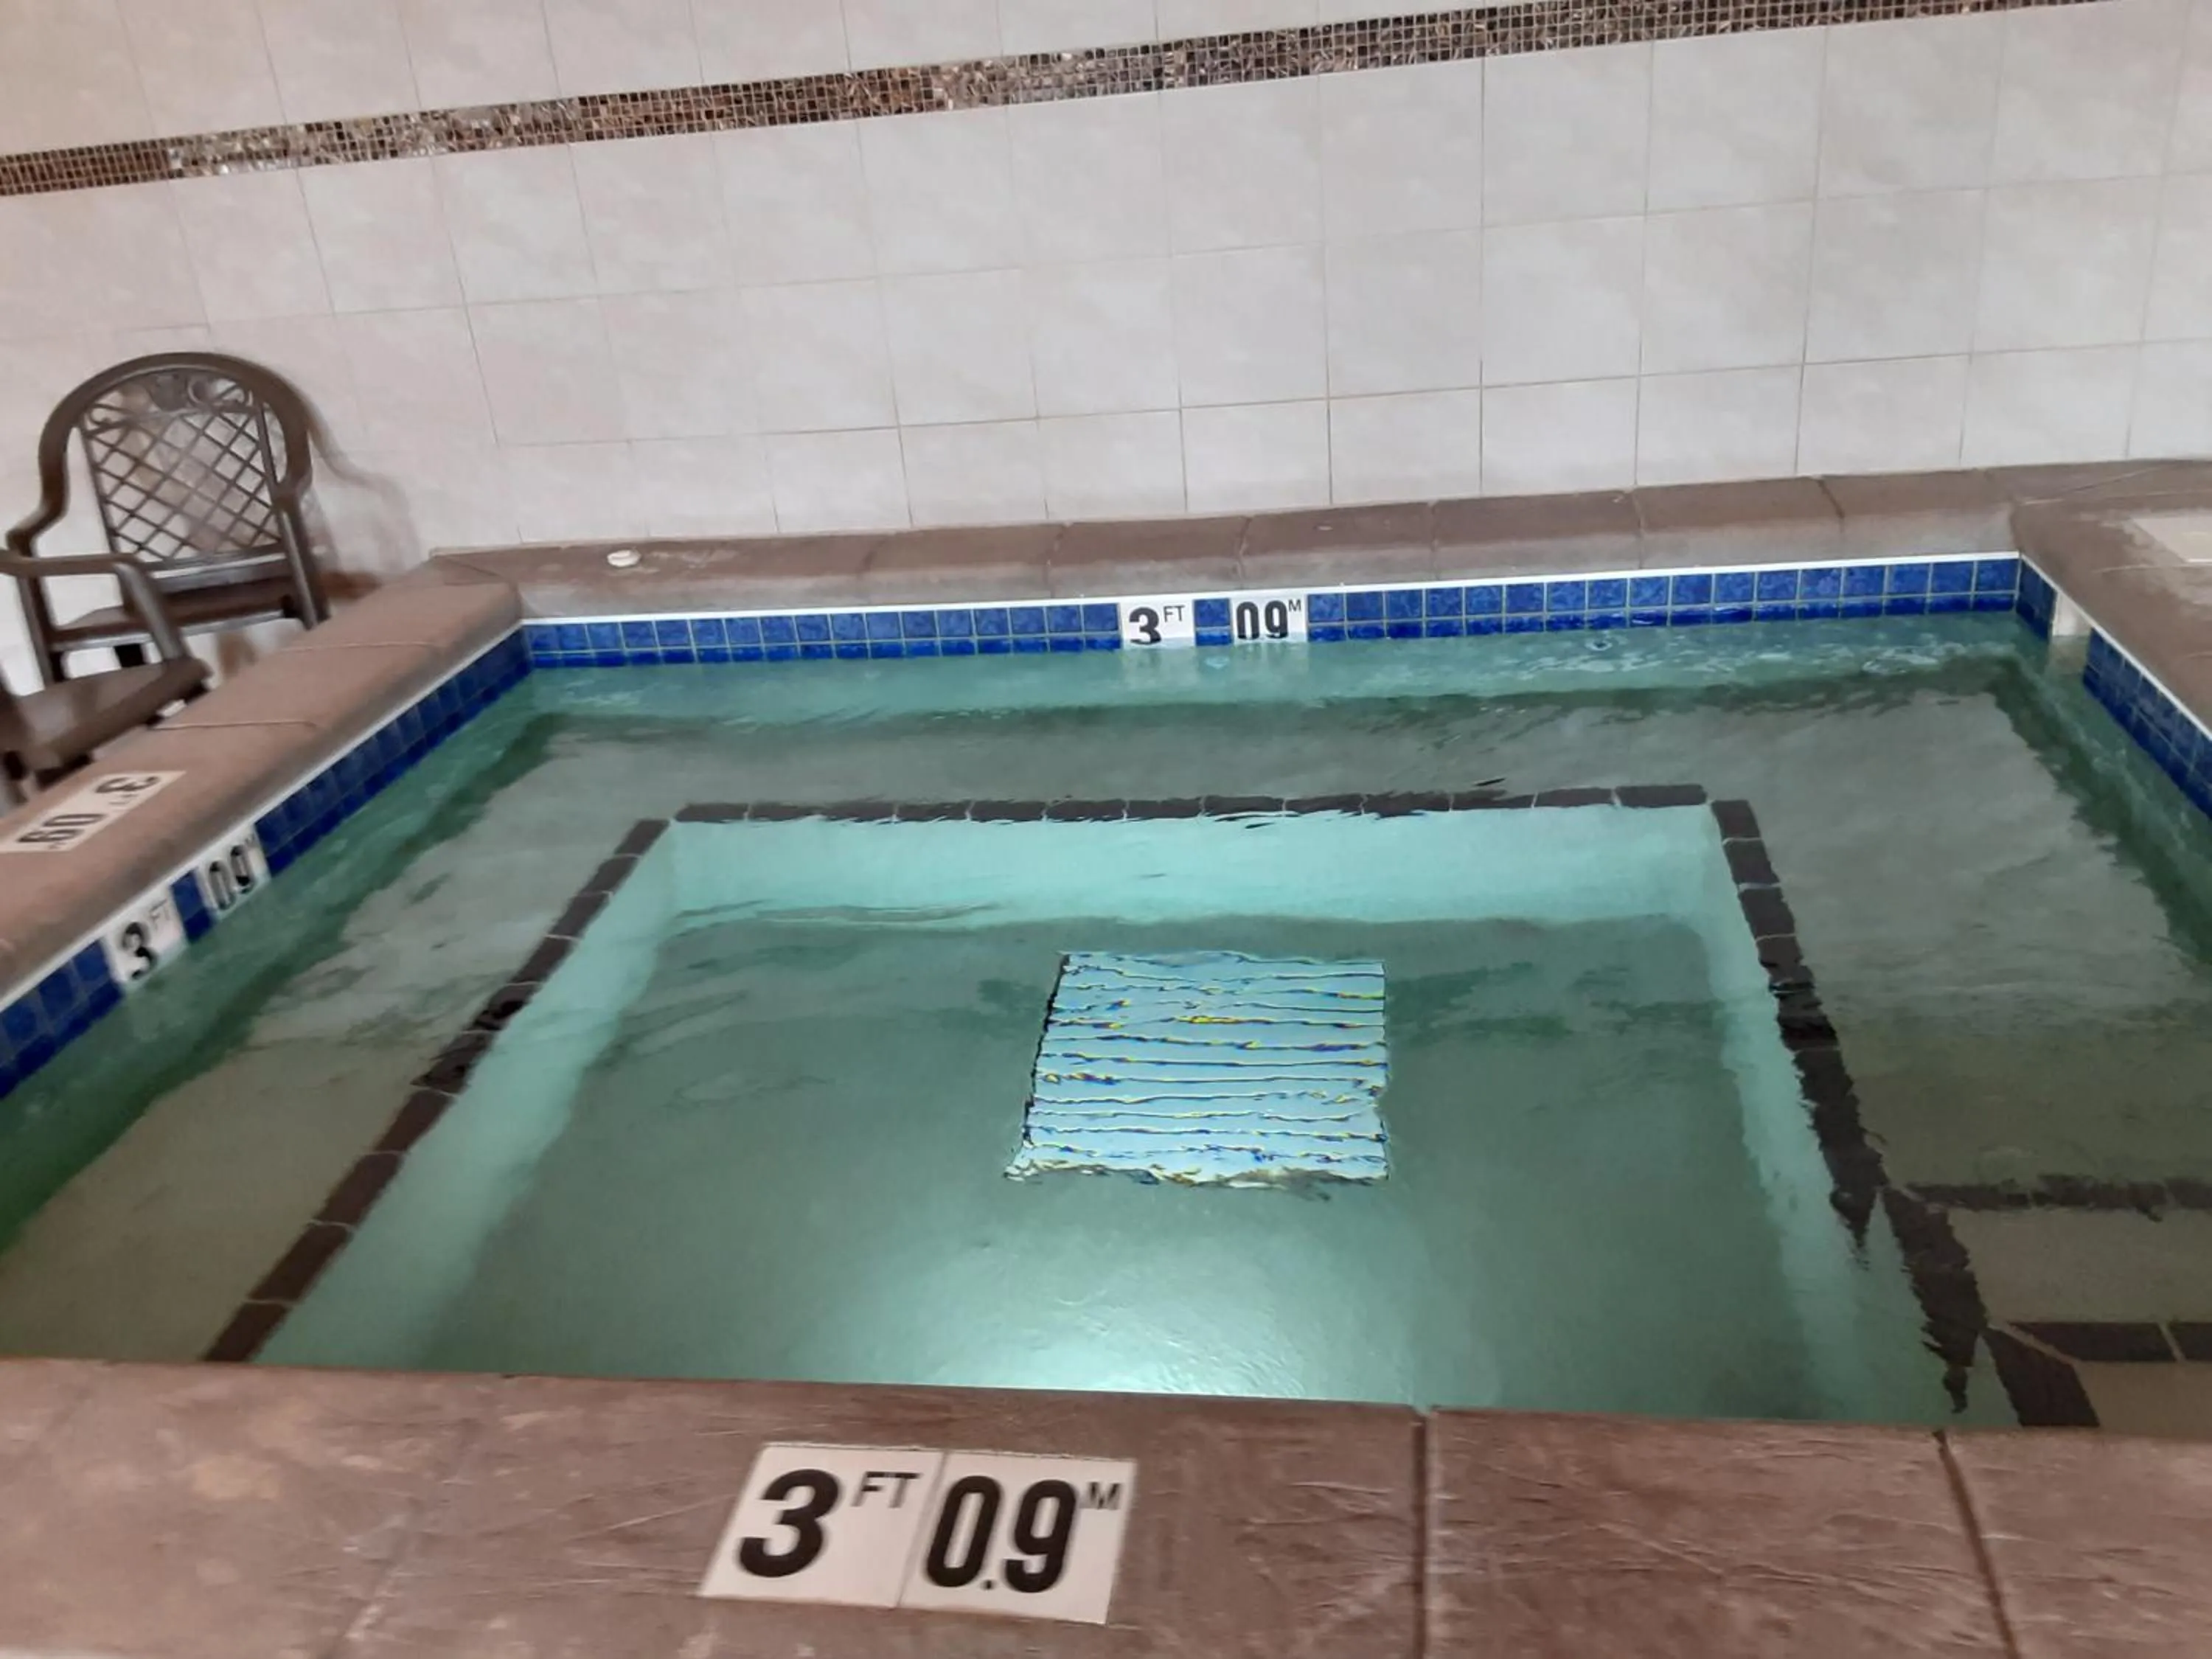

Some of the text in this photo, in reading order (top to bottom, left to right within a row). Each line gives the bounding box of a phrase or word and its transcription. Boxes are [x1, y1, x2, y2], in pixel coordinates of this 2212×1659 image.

[1129, 605, 1185, 644] 3 FT
[1288, 599, 1302, 612] M
[120, 922, 159, 981] 3
[738, 1468, 921, 1578] 3 FT
[925, 1475, 1122, 1594] 0.9 M
